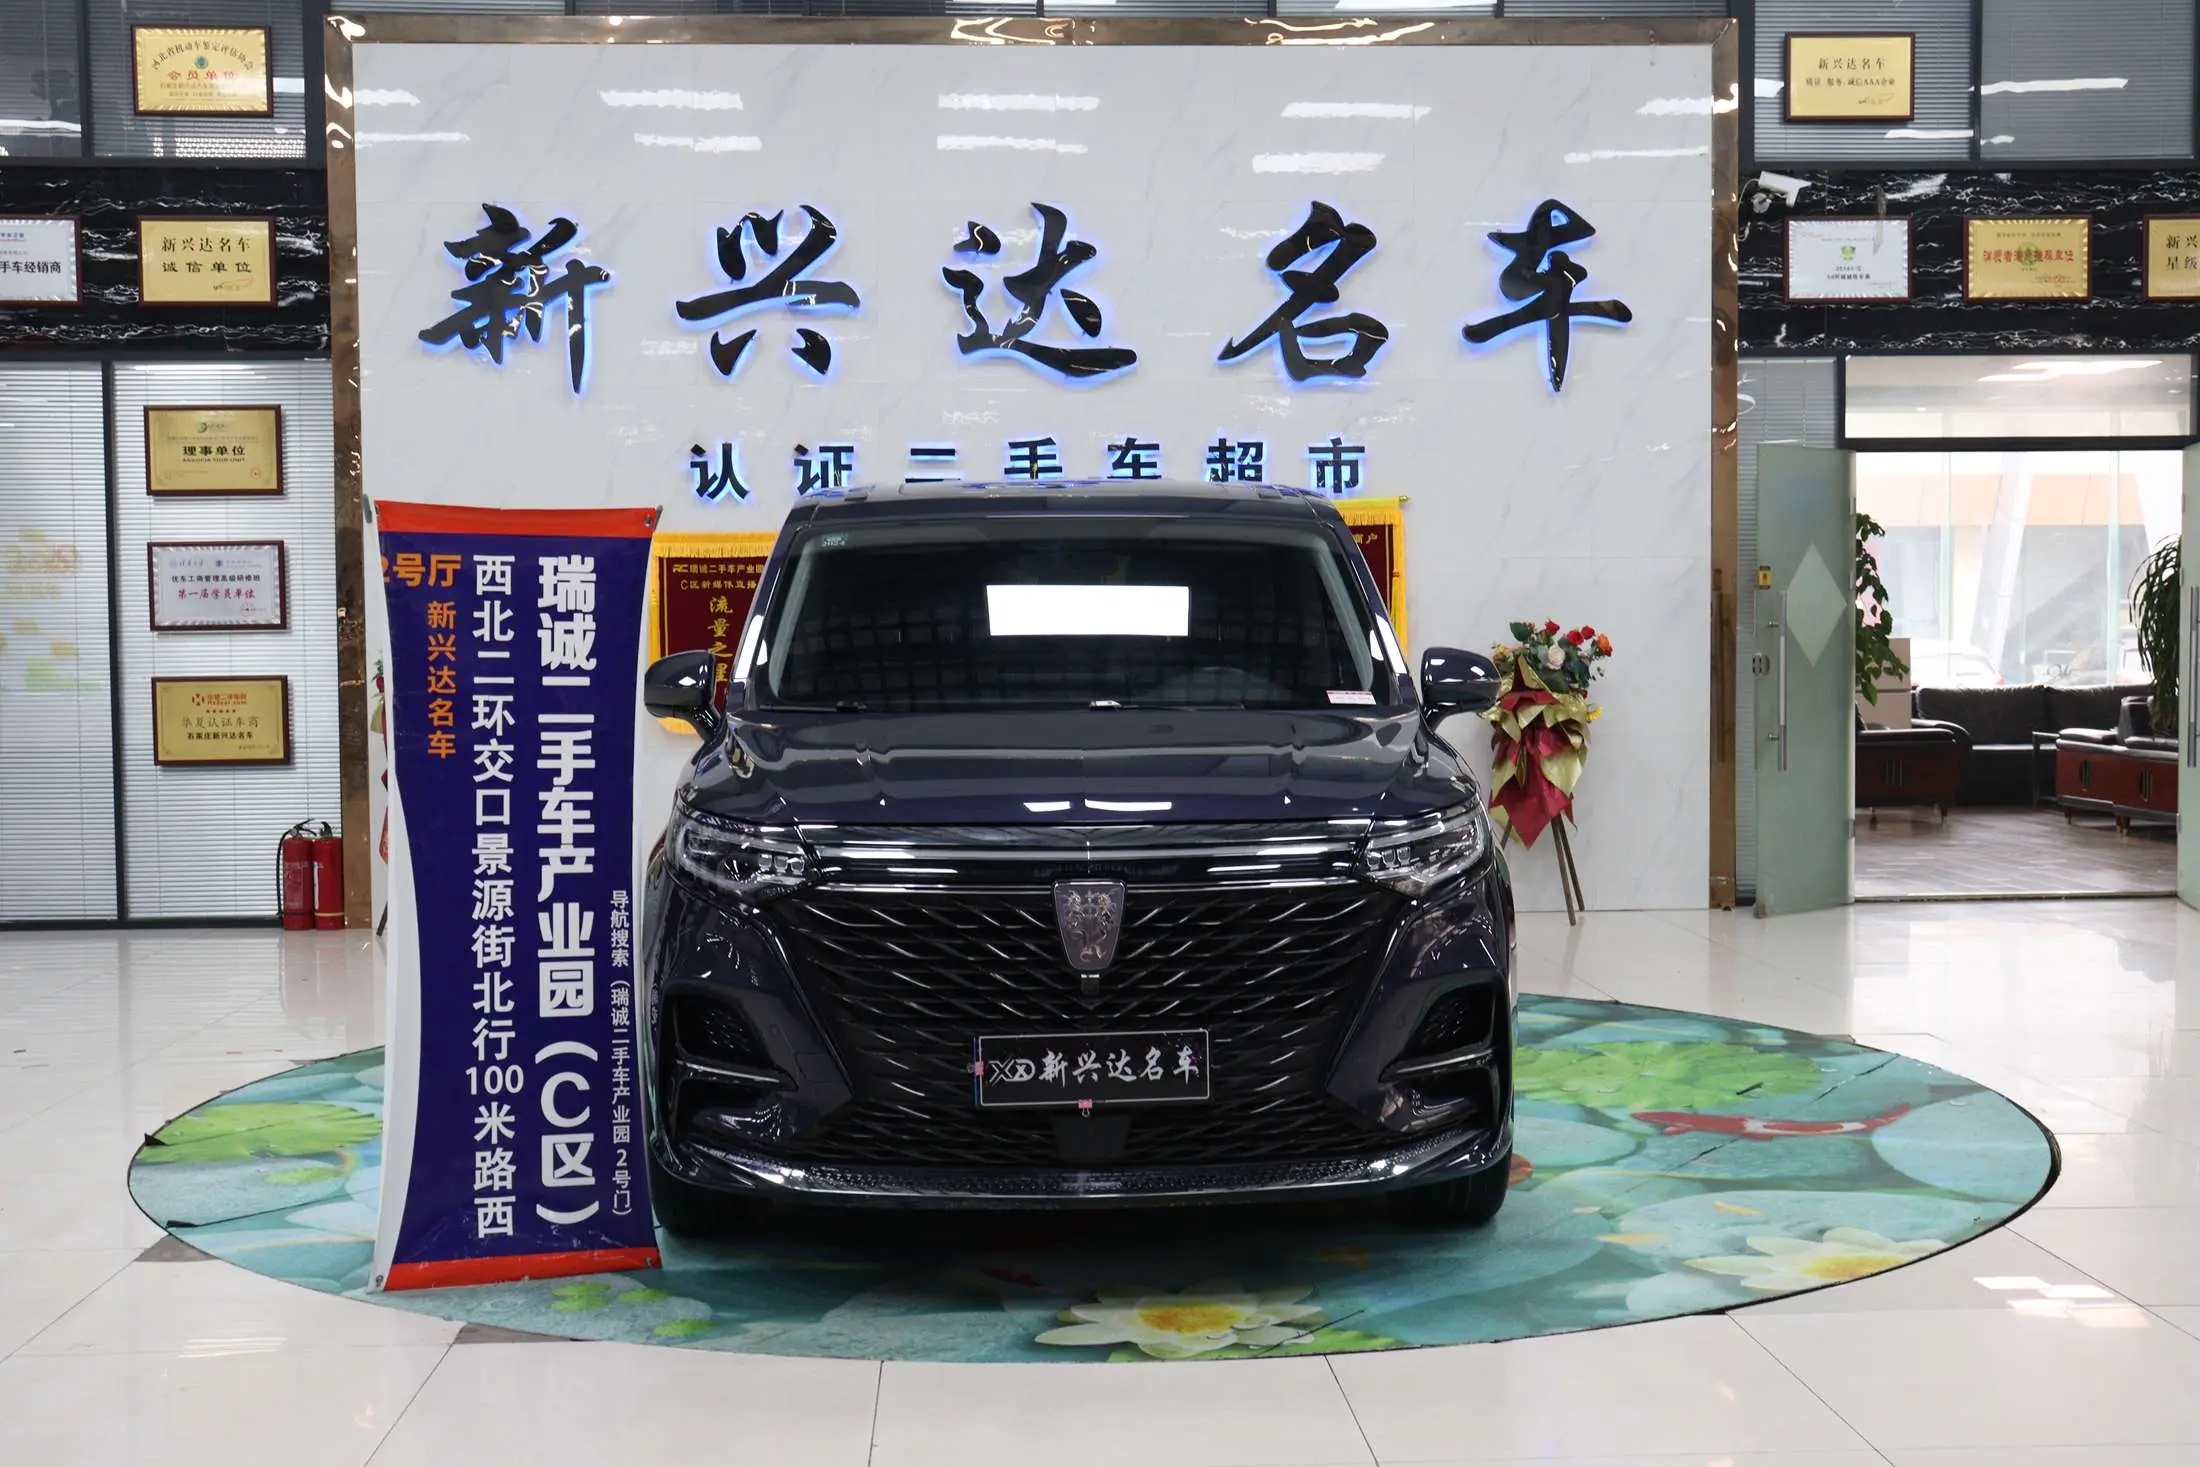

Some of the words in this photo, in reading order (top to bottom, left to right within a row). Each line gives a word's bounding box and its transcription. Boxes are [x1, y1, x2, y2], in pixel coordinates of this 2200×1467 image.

[1818, 57, 1887, 71] 新兴达名车
[161, 236, 251, 253] 新兴达名车
[162, 261, 252, 273] 诚信单位
[418, 200, 1633, 393] 新兴达名车
[182, 445, 246, 457] 理事单位
[690, 437, 1366, 499] 认证二手车超市
[178, 588, 255, 600] 第一届学员单位
[427, 601, 457, 759] 新兴达名车
[465, 554, 525, 1239] 西北二环交口景源街北行100米路西
[1038, 1045, 1201, 1088] 新兴达名车
